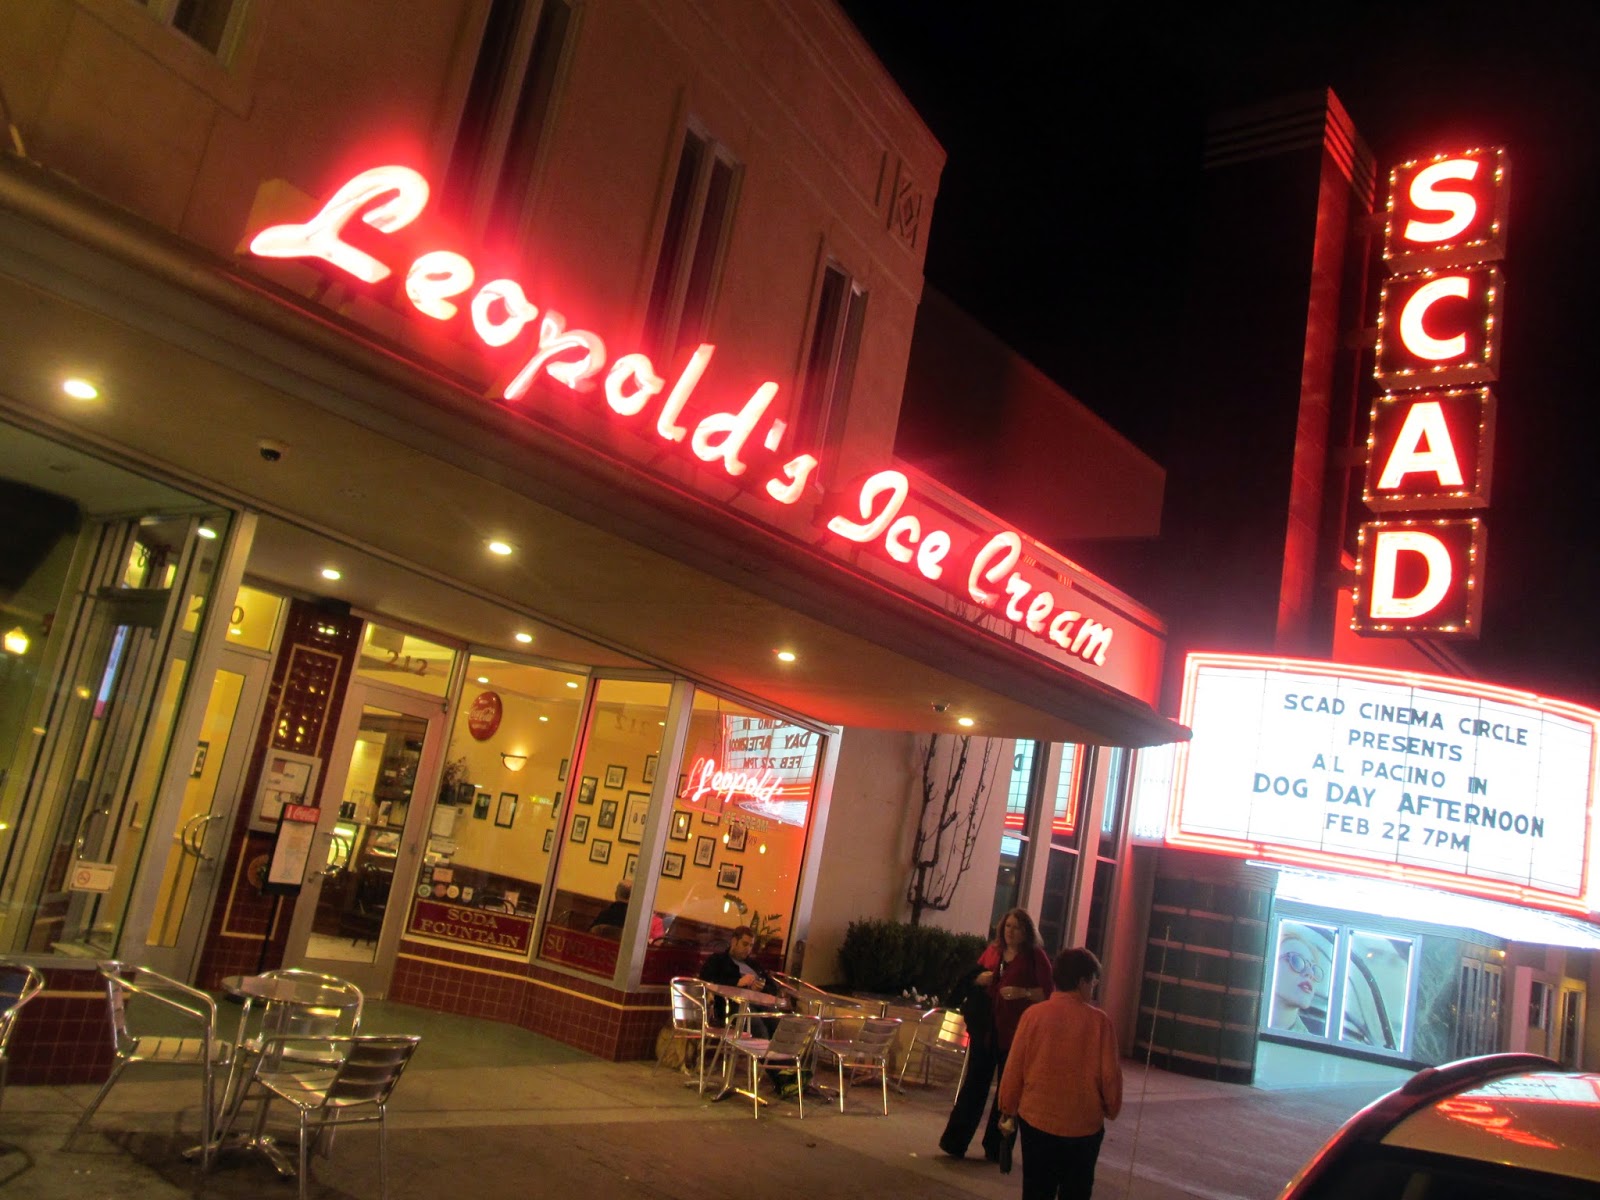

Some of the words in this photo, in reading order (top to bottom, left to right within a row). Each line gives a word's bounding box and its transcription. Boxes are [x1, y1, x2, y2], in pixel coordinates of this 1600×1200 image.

[1369, 159, 1480, 619] SCAD
[250, 165, 818, 504] Leopold's
[827, 470, 951, 580] Ice
[968, 531, 1114, 667] Cream
[387, 650, 428, 676] 212
[1284, 693, 1345, 715] SCAD
[1359, 702, 1444, 730] CINEMA
[1459, 717, 1528, 746] CIRCLE
[1348, 729, 1462, 762] PRESENTS
[1312, 753, 1344, 773] AL
[1361, 760, 1446, 788] PACINO
[1467, 776, 1488, 796] IN
[1252, 772, 1308, 799] DOG
[1326, 781, 1376, 807] DAY
[1397, 792, 1544, 838] AFTERNOON
[1325, 813, 1370, 835] FEB
[1382, 822, 1410, 842] 22
[1423, 827, 1470, 853] 7PM
[420, 918, 520, 948] FOUNTAIN
[447, 909, 498, 929] SODA
